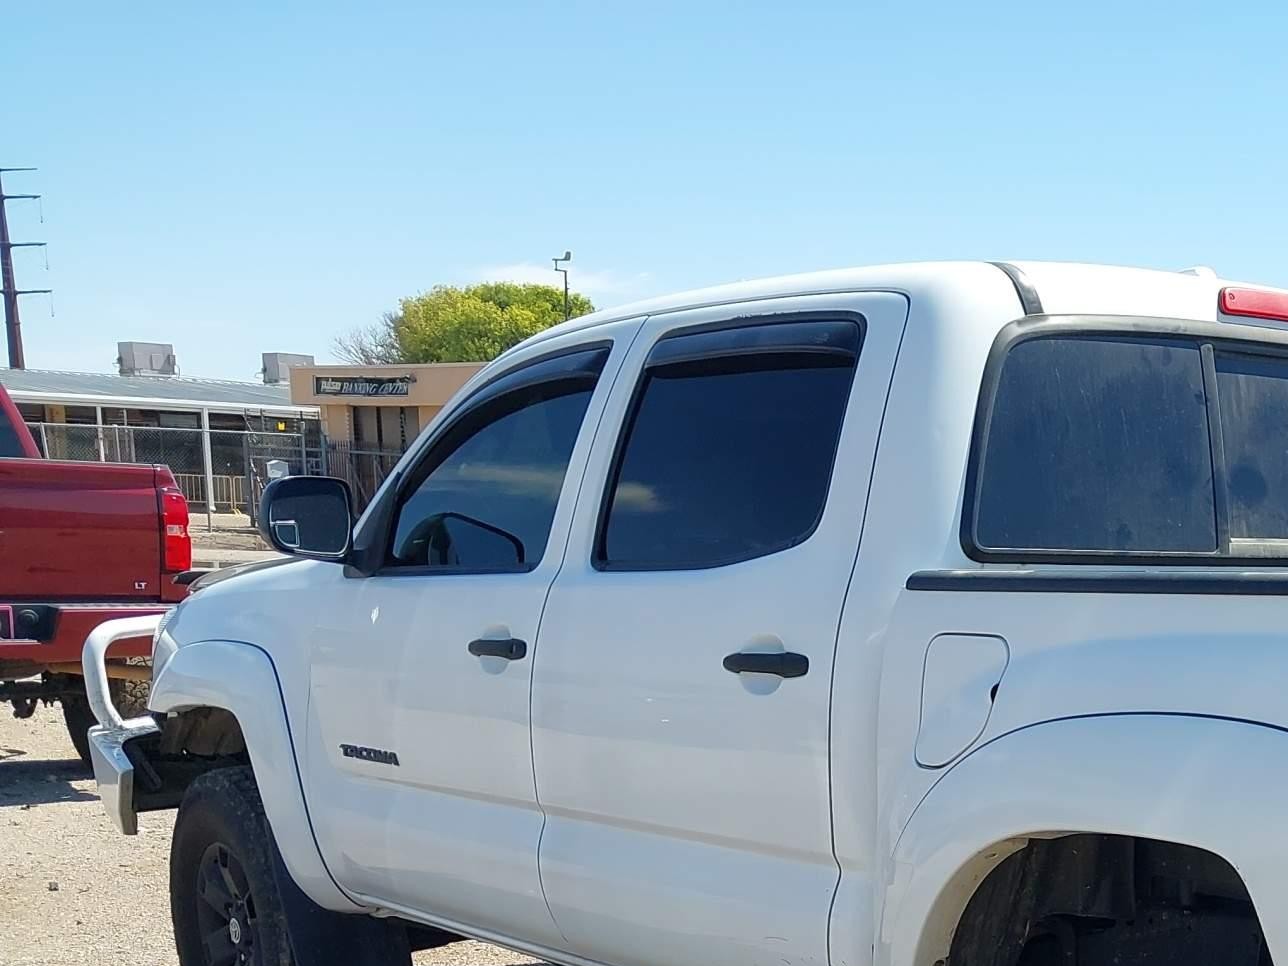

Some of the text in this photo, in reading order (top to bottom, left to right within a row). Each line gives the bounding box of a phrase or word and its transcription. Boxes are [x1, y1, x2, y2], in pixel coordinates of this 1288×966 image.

[379, 381, 408, 394] CENTER
[134, 581, 148, 591] LT
[338, 743, 400, 767] TACOMA
